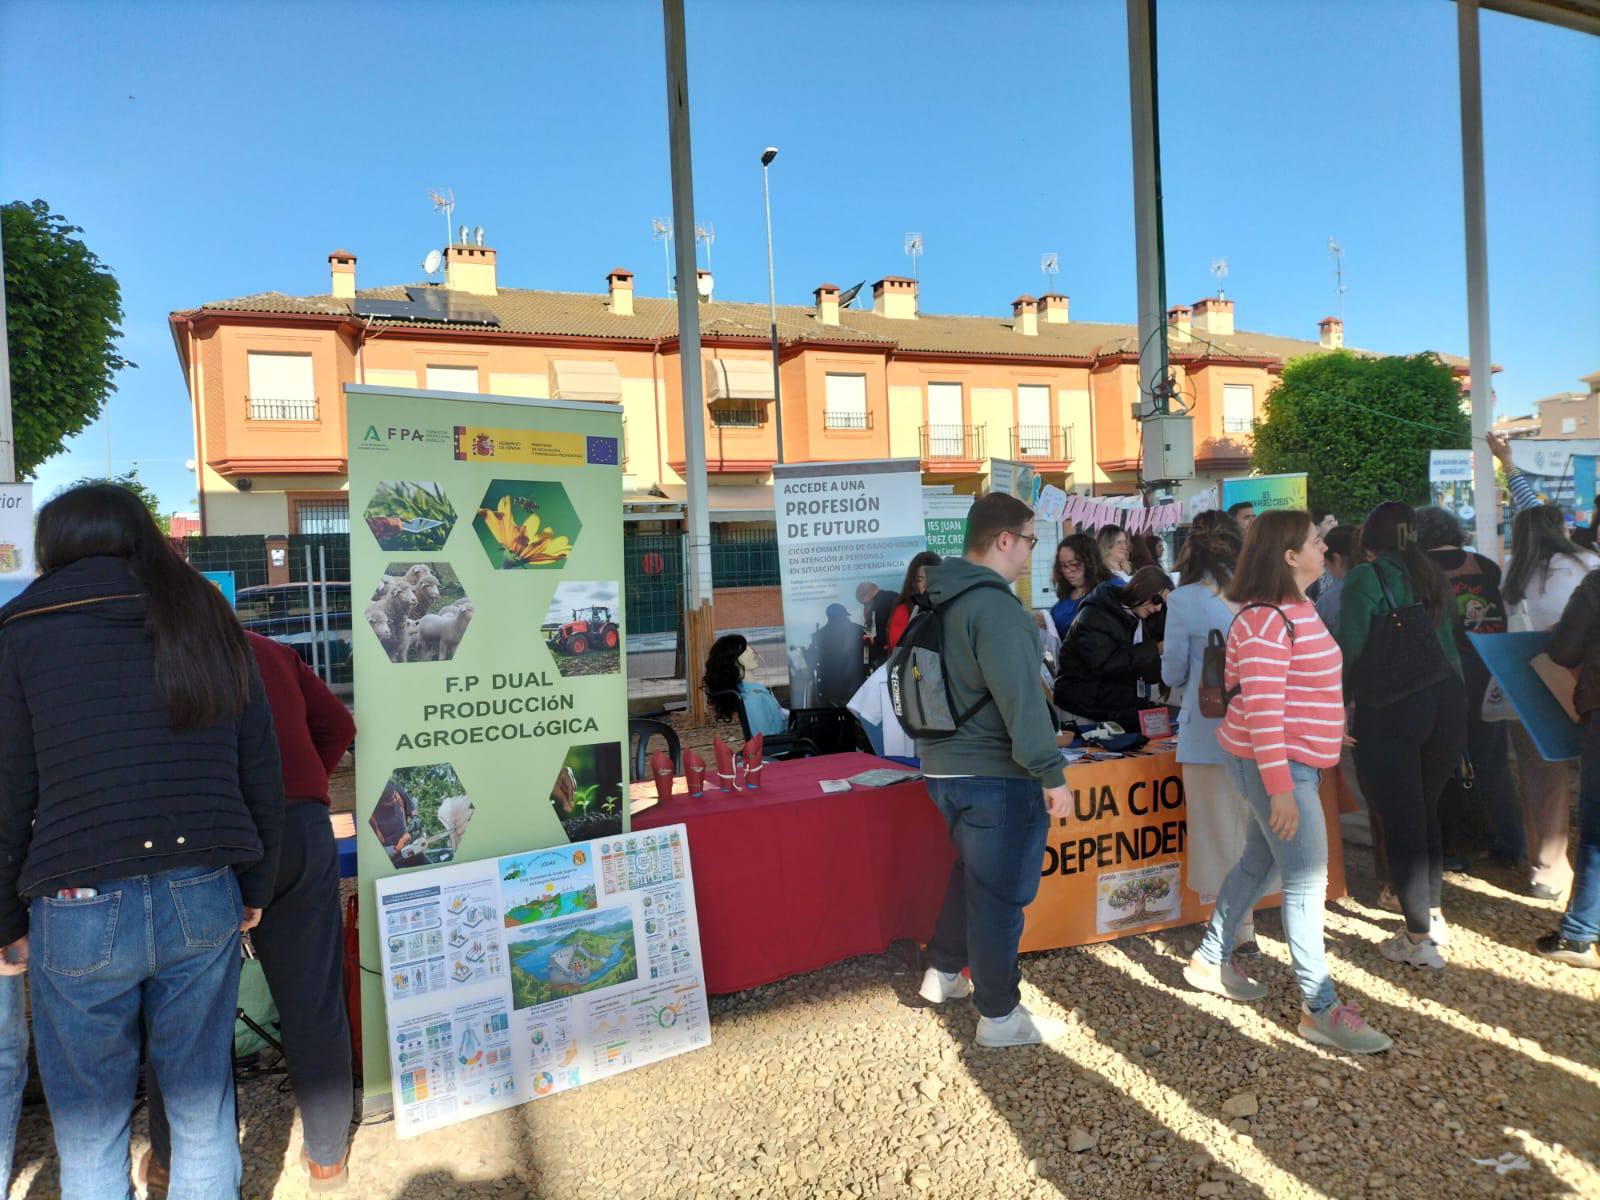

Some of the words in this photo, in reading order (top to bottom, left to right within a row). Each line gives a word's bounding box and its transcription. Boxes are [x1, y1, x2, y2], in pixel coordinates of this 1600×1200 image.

[784, 481, 827, 495] ACCEDE
[830, 481, 838, 492] A
[840, 480, 865, 491] UNA
[0, 492, 22, 509] ior
[786, 493, 880, 516] PROFESIÓN
[788, 523, 809, 539] DE
[814, 518, 880, 537] FUTURO
[928, 521, 939, 530] IES
[940, 521, 961, 532] JUAN
[927, 533, 947, 545] ÉREZ
[788, 547, 810, 556] CICLO
[811, 544, 855, 554] FORMATIVO
[856, 543, 866, 551] DE
[868, 541, 894, 549] GRADO
[845, 552, 884, 562] PERSONAS
[790, 567, 800, 575] EN
[801, 563, 840, 574] SITUACIÓN
[842, 563, 852, 571] DE
[853, 560, 905, 570] DEPENDENCIA
[446, 676, 479, 693] F.P
[492, 671, 553, 690] DUAL
[1060, 785, 1119, 826] UA
[1128, 775, 1186, 816] CIO
